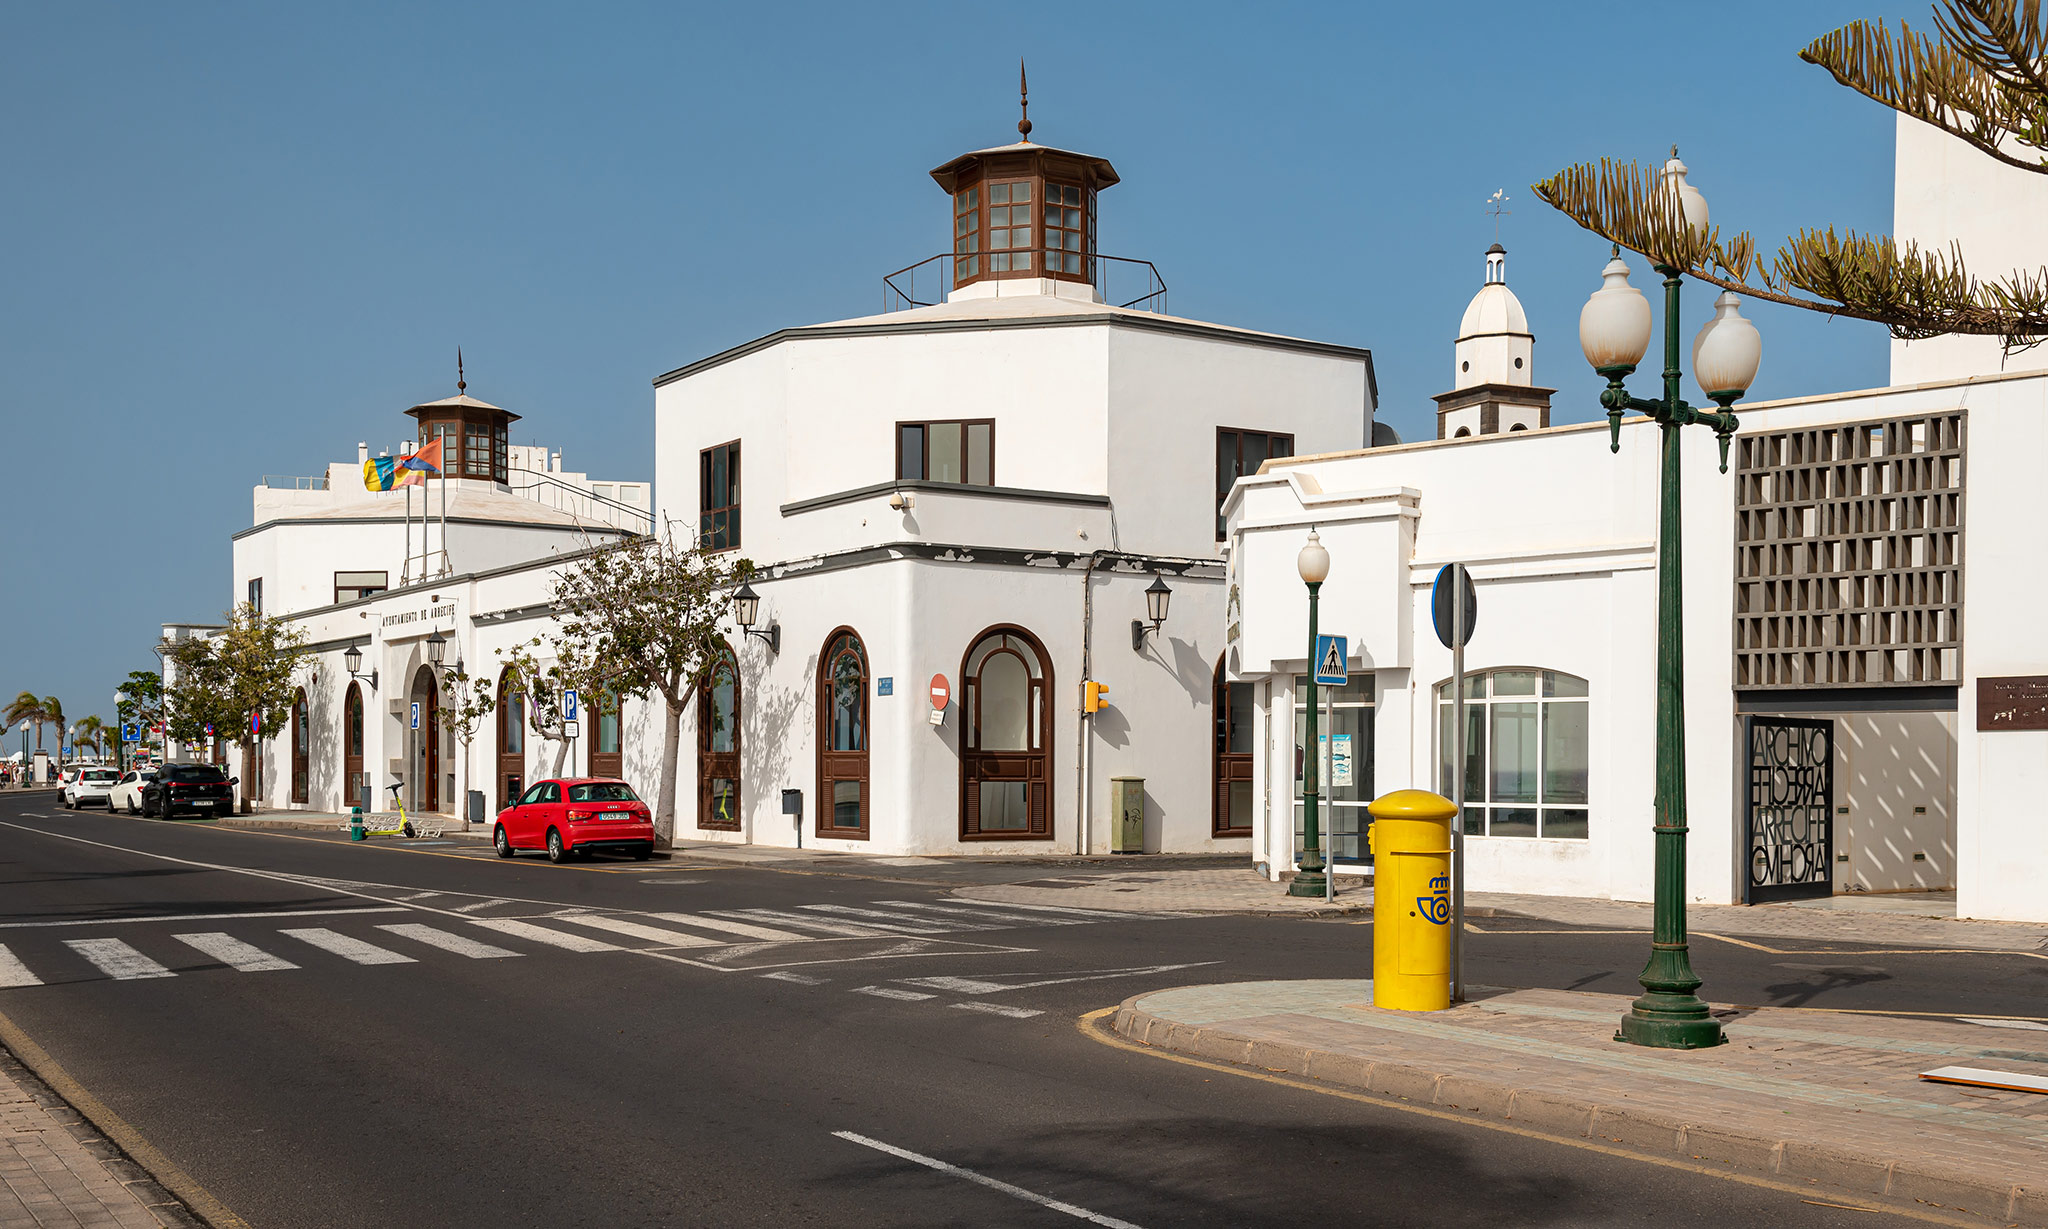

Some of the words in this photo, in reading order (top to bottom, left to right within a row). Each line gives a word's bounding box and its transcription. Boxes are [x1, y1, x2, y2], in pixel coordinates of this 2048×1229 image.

[382, 611, 418, 627] AYUNTAMIENTO
[421, 609, 427, 620] DE
[431, 604, 455, 618] ARRECIFE
[567, 693, 575, 718] P
[1753, 727, 1827, 766] ARCHIVO
[1753, 805, 1827, 845] ARRECIFE
